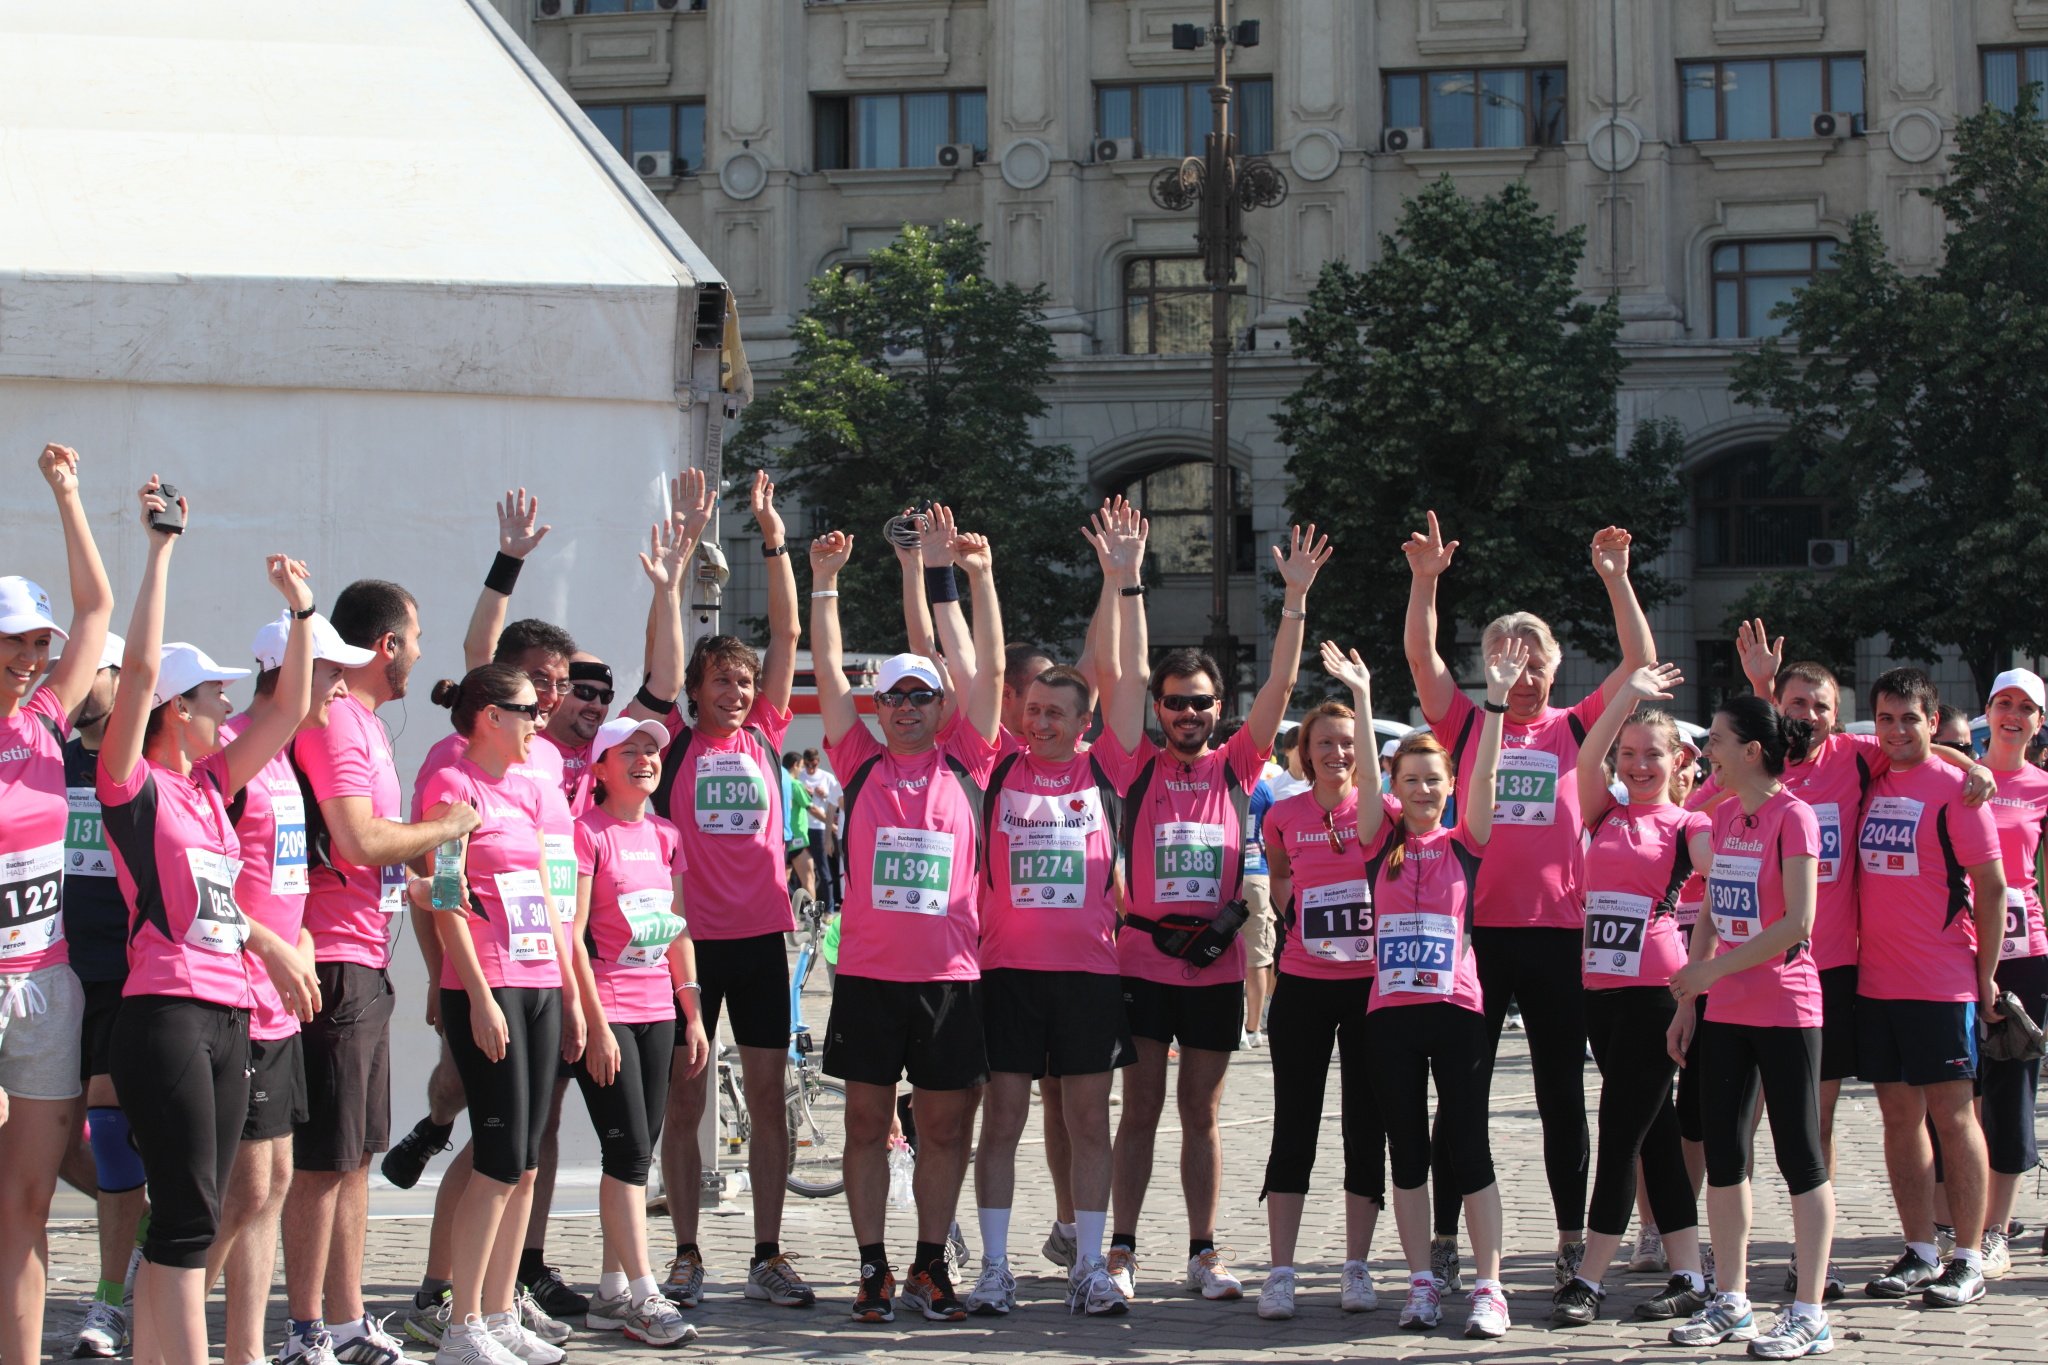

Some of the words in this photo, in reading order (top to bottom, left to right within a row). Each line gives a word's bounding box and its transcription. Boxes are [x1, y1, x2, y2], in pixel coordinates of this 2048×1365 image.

[1520, 761, 1557, 770] MARATHON
[1033, 774, 1071, 788] Narcis
[1862, 822, 1911, 848] 2044
[915, 842, 952, 853] MARATHON
[1722, 837, 1764, 852] Mihaela
[621, 848, 657, 861] Sanda
[6, 859, 35, 869] Bucharest
[6, 867, 27, 878] HALF
[1726, 869, 1758, 878] MARATHON
[5, 880, 58, 918] 122
[207, 886, 237, 918] 125
[1323, 895, 1341, 903] HALF
[1611, 905, 1648, 915] MARATHON
[1323, 908, 1373, 932] 115
[1417, 925, 1456, 935] MARATHON
[1592, 920, 1637, 944] 107
[2, 941, 26, 950] PETROM
